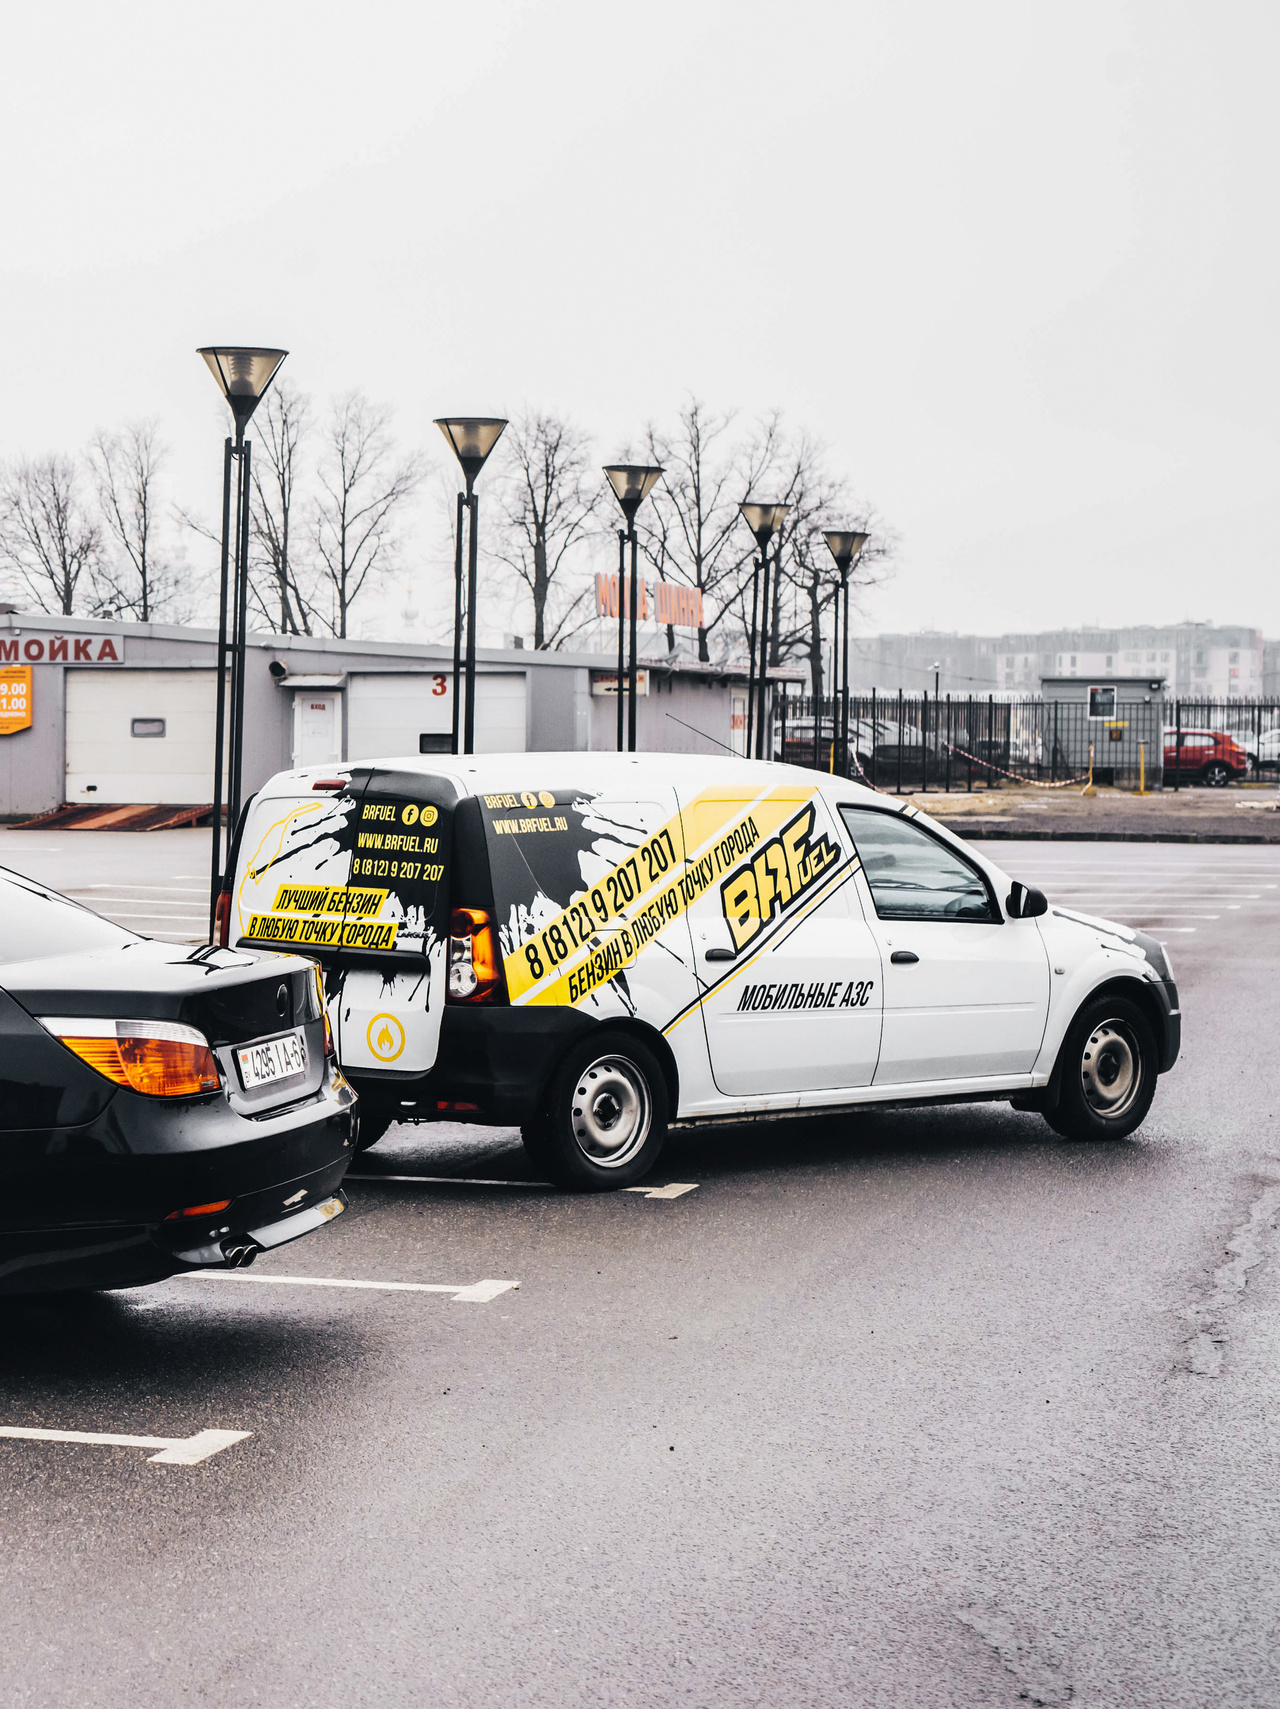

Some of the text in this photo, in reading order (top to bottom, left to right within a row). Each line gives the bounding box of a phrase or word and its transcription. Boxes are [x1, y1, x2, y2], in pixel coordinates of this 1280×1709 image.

[431, 673, 447, 696] 3
[362, 804, 396, 821] BRFUEL
[483, 794, 521, 809] BRFUEL
[492, 816, 568, 835] WWW.BRFUEL.RU
[357, 832, 439, 854] WWW.BRFUEL.RU
[353, 858, 445, 882] 8 (812) 9 207 207
[276, 887, 383, 915] ЛУЧШИЙ БЕНЗИН
[525, 829, 677, 980] 8 (812) 9 207 207
[568, 816, 760, 1004] БЕНЗИН В ЛЮБУЮ ТОЧКУ ГОРОДА
[248, 917, 393, 948] В ЛЮБУЮ ТОЧКУ ГОРОДА
[737, 981, 874, 1011] МОБИЛЬНЫЕ АЗС
[251, 1046, 275, 1080] 4295
